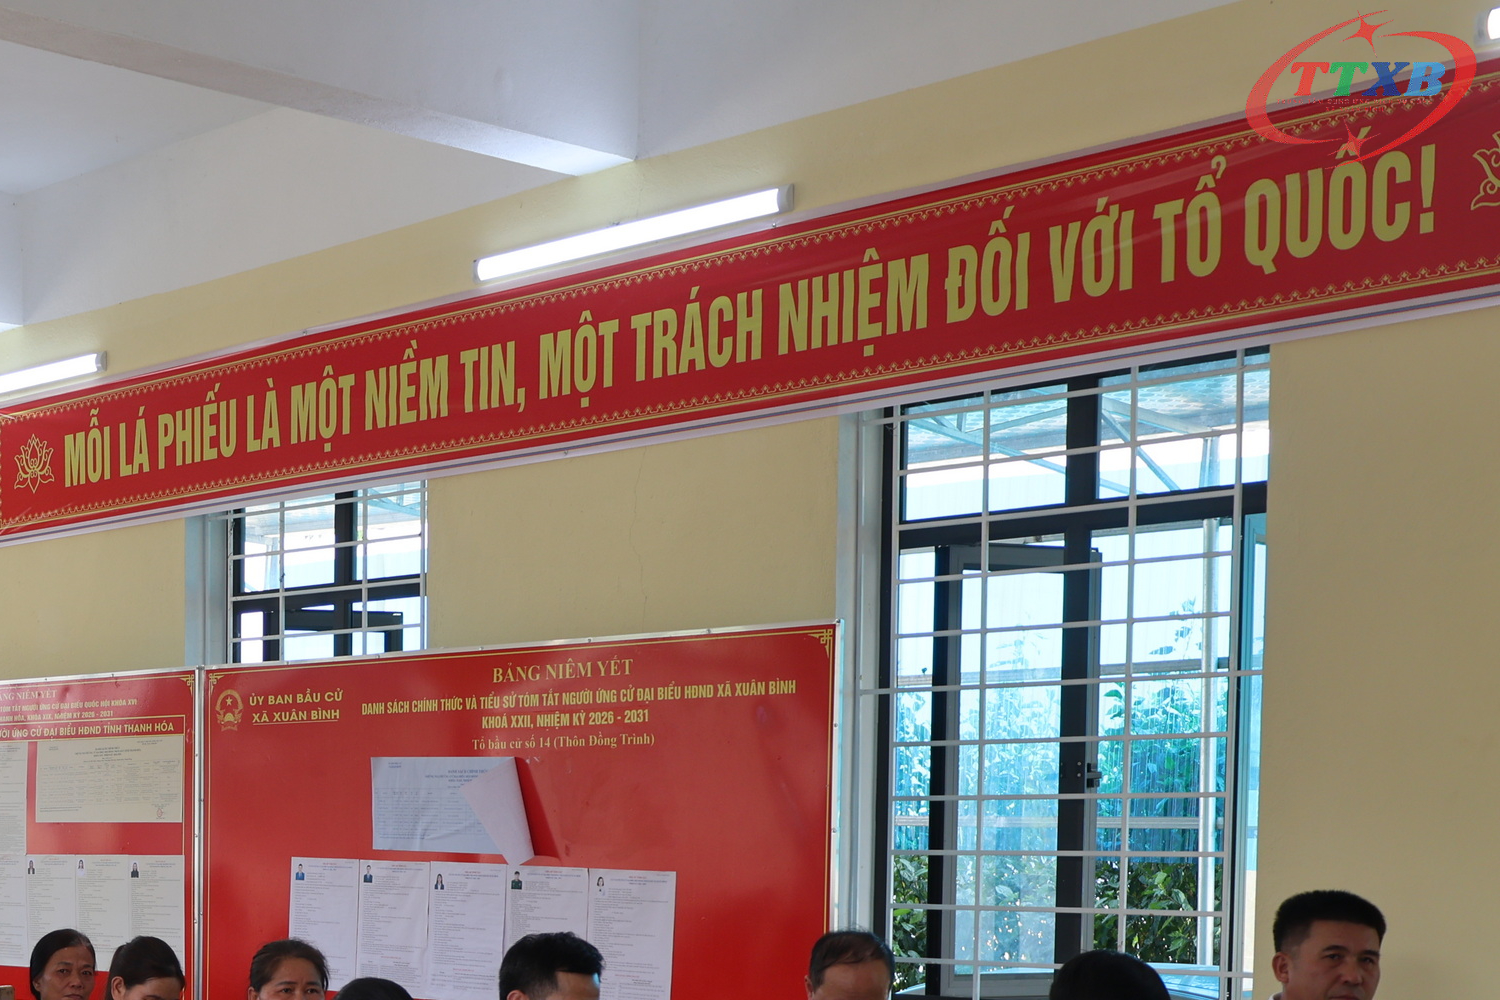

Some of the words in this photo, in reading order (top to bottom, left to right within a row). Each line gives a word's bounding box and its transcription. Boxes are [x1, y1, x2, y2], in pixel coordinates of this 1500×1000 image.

[64, 407, 111, 487] MỖI
[119, 406, 150, 477] LÁ
[158, 383, 237, 469] PHIẾU
[247, 378, 281, 453] LÀ
[290, 365, 355, 453] MỘT
[365, 340, 449, 430] NIỀM
[460, 341, 526, 413] TIN,
[539, 310, 619, 408] MỘT
[630, 286, 763, 382] TRÁCH
[778, 247, 929, 357] NHIỆM
[945, 205, 1030, 323] ĐỐI
[1049, 197, 1135, 303] VỚI
[1153, 155, 1227, 283] TỔ
[1244, 126, 1436, 274] QUỐC!
[492, 663, 541, 683] BẢNG
[546, 658, 592, 680] NIÊM
[597, 655, 634, 677] YẾT
[249, 691, 265, 706] ỦY
[268, 694, 292, 705] BAN
[297, 688, 321, 704] BẦU
[324, 689, 344, 702] CỬ
[362, 703, 385, 716] DANH
[387, 699, 410, 714] SÁCH
[412, 697, 437, 713] CHÍNH
[440, 696, 463, 712] THỨC
[466, 694, 477, 710] VÀ
[480, 691, 500, 709] TIỂU
[502, 691, 516, 708] SỬ
[518, 693, 539, 707] TÓM
[542, 688, 560, 706] TẮT
[562, 688, 593, 705] NGƯỜI
[596, 687, 617, 704] ỨNG
[620, 684, 635, 702] CỬ
[636, 688, 654, 704] ĐẠI
[658, 681, 681, 700] BIỂU
[684, 684, 714, 699] HĐND
[717, 681, 732, 697] XÃ
[735, 679, 765, 696] XUÂN
[768, 678, 796, 695] BÌNH
[252, 711, 269, 723] XÃ
[273, 708, 307, 722] XUÂN
[311, 709, 340, 720] BÌNH
[482, 713, 508, 729] KHOÁ
[510, 715, 533, 729] XXII,
[536, 711, 570, 730] NHIỆM
[573, 710, 586, 726] KỲ
[589, 711, 614, 725] 2026
[624, 709, 649, 723] 2031
[12, 726, 28, 738] ỨNG
[30, 726, 42, 737] CỬ
[44, 727, 58, 738] ĐẠI
[60, 722, 76, 736] BIỂU
[78, 725, 101, 736] HĐND
[104, 722, 122, 734] TỈNH
[124, 724, 152, 733] THANH
[154, 720, 174, 732] HÓA
[472, 736, 486, 750] Tổ
[488, 735, 507, 750] bầu
[510, 737, 523, 749] cử
[525, 735, 536, 749] số
[540, 737, 551, 748] 14
[554, 735, 586, 750] (Thôn
[589, 731, 617, 749] Đồng
[620, 733, 655, 747] Trình)
